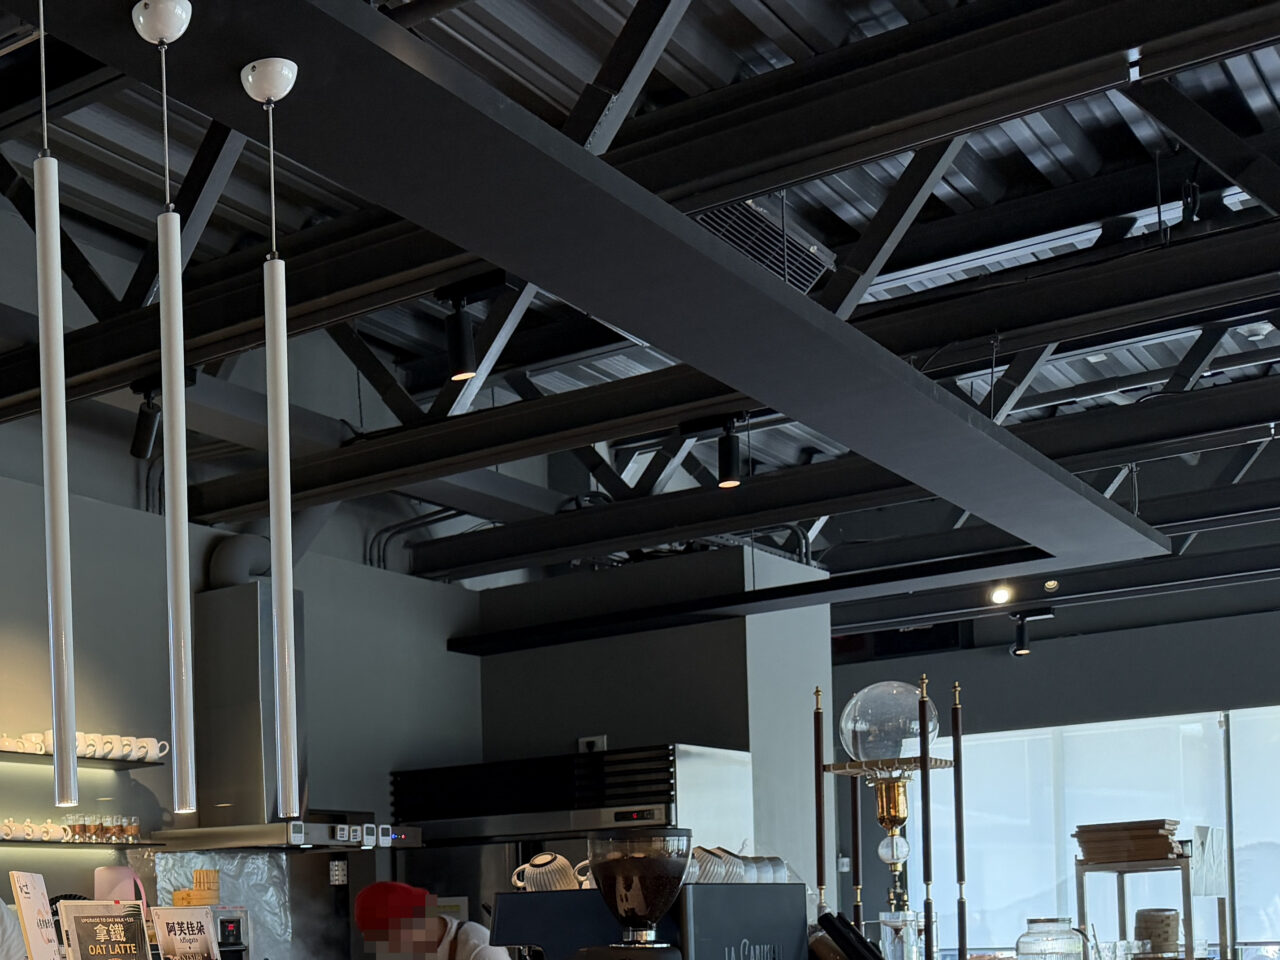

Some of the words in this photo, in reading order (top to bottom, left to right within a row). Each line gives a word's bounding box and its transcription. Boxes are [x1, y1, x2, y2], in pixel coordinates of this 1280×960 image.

[94, 923, 126, 942] 拿鐵
[165, 920, 206, 937] 阿芙佳朵
[88, 945, 106, 955] OAT
[109, 943, 137, 955] LATTE
